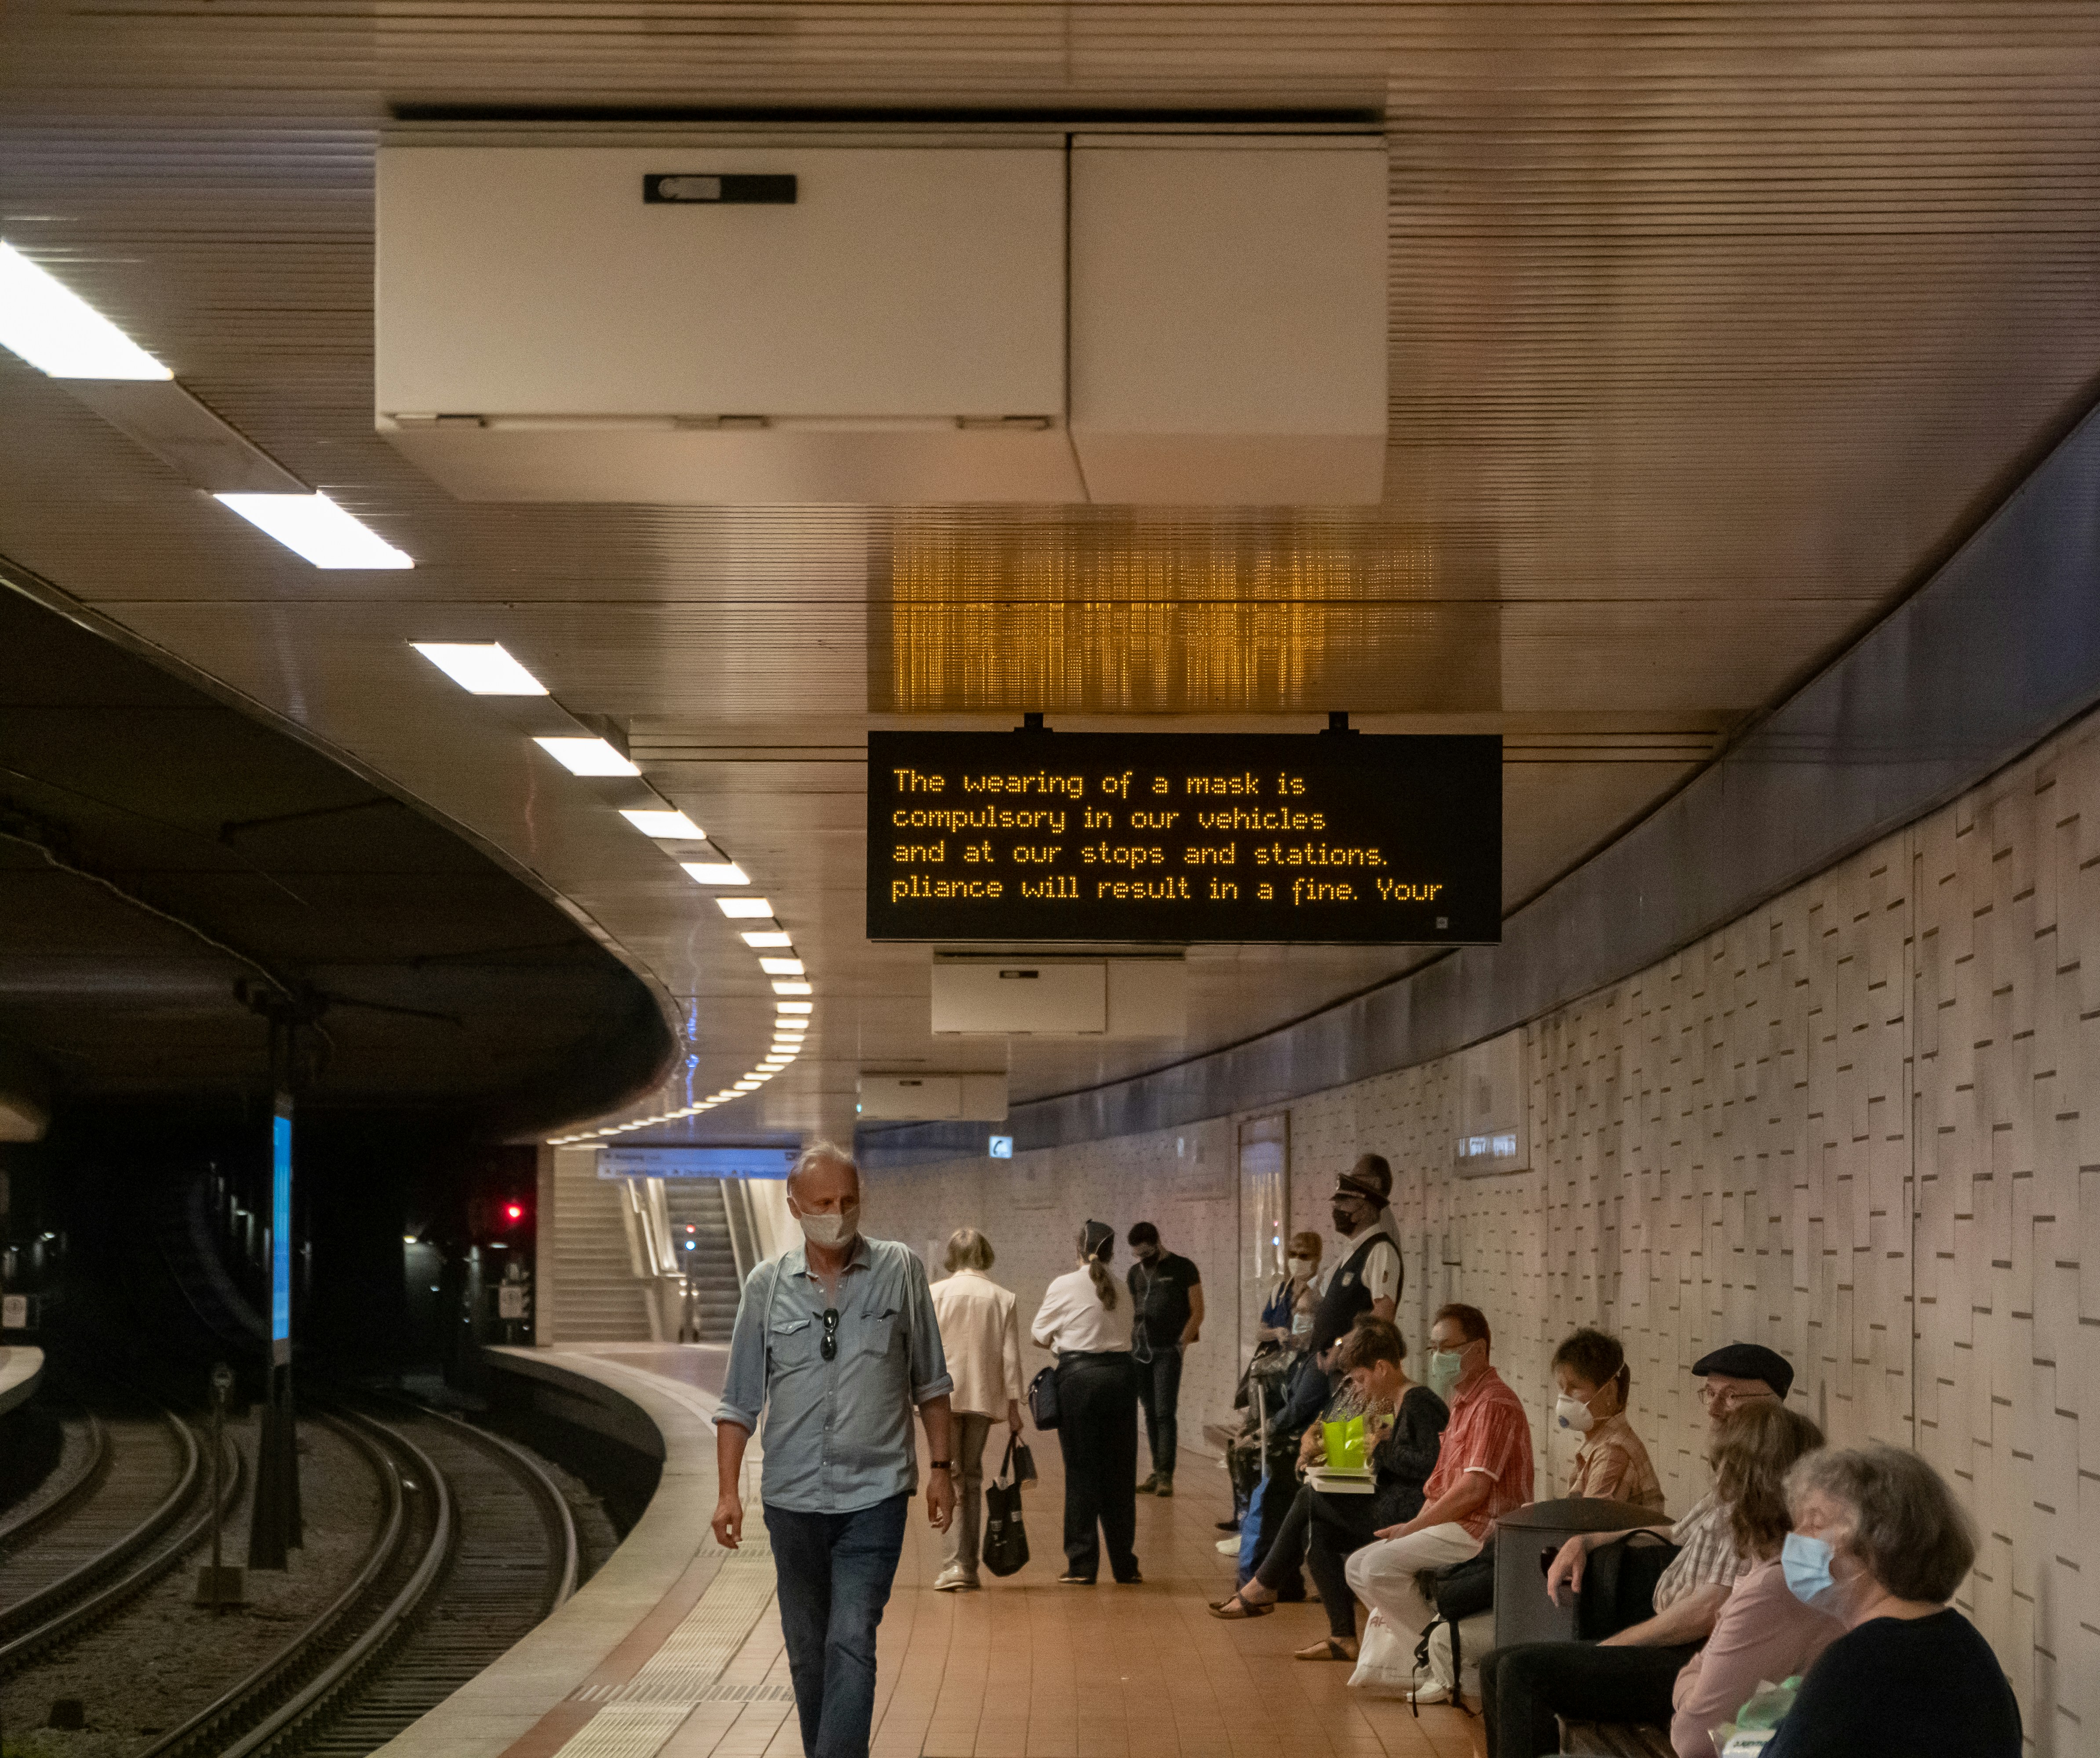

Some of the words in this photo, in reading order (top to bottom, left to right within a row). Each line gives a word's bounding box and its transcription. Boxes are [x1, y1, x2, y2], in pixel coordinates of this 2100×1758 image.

[893, 769, 946, 793] The
[964, 770, 1084, 799] wearing
[1102, 771, 1133, 799] of
[1152, 777, 1169, 795] a
[1187, 772, 1259, 795] mask
[1278, 772, 1307, 795] is
[893, 805, 1066, 834] compulsory
[1085, 806, 1113, 829] in
[1131, 812, 1180, 829] our
[1198, 807, 1326, 830] vehicles
[893, 840, 946, 863] and
[964, 840, 995, 863] at
[1014, 846, 1063, 864] our
[1081, 841, 1165, 870] stops
[1184, 842, 1236, 865] and
[1254, 842, 1388, 866] stations.
[892, 875, 1004, 904] pliance
[1022, 875, 1080, 899] will
[1098, 876, 1191, 900] result
[1210, 877, 1238, 900] in
[1257, 883, 1274, 900] a
[1292, 878, 1358, 906] fine.
[1377, 878, 1443, 901] Your
